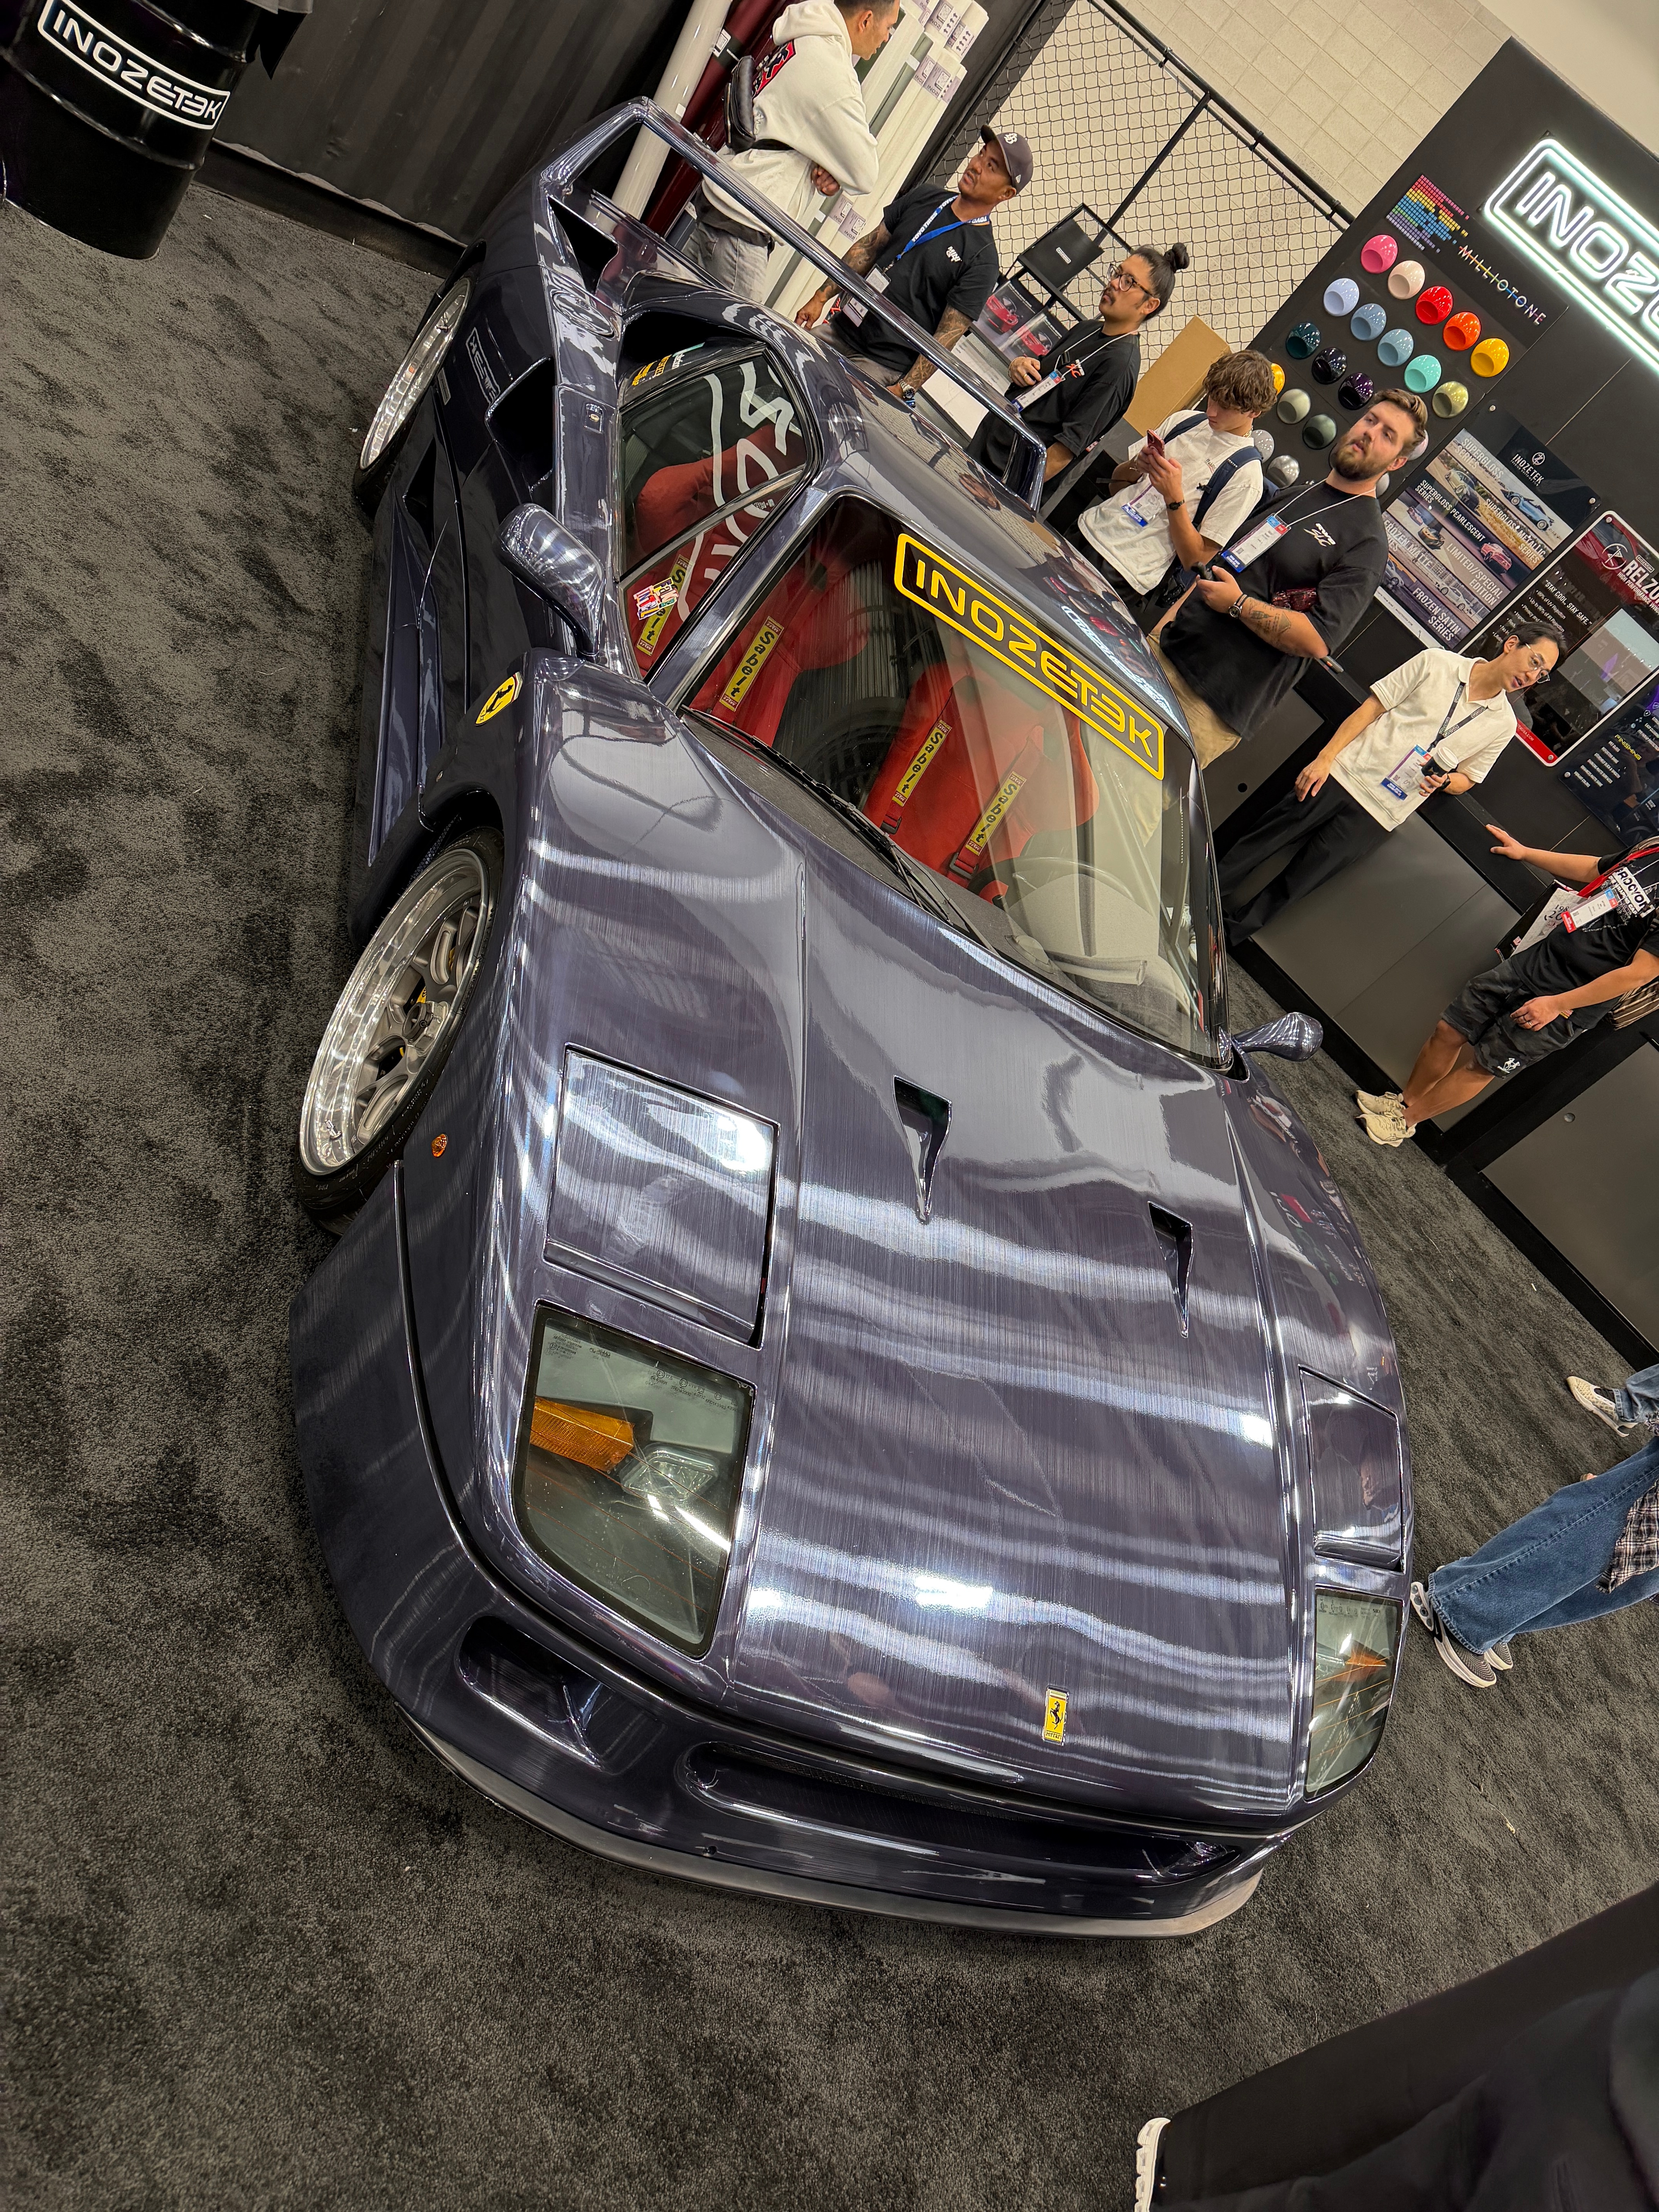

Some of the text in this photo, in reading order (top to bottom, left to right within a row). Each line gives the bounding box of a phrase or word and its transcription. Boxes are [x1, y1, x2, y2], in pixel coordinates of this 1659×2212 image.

[53, 10, 222, 120] INOZETEK
[912, 211, 938, 242] TOYO TIRES
[1515, 170, 1659, 335] INOZ
[1458, 245, 1547, 326] MILLIOTONE
[1454, 445, 1480, 470] SERIES
[1461, 437, 1504, 479] SUPERGLOSS
[1512, 453, 1544, 484] INOZETEK
[1414, 485, 1434, 504] SERIES
[1419, 479, 1486, 543] SUPERGLOSS PEARLESCENT
[1483, 498, 1546, 558] SUPERGLOSS METALLIC
[1381, 519, 1433, 569] FROZEN MATTE
[1517, 543, 1540, 564] SERIES
[1468, 578, 1497, 606] EDITION
[1617, 571, 1628, 582] HIGH
[1625, 579, 1652, 605] PERFORMANCE
[1622, 560, 1659, 606] RELZO
[647, 569, 685, 641] Selt
[1412, 587, 1441, 616] FROZEN
[1437, 611, 1462, 635] SATIN
[1551, 605, 1566, 620] Rejection
[1566, 602, 1579, 615] STAY
[766, 622, 781, 632] TRW
[1427, 615, 1455, 642] SERIES
[1550, 618, 1565, 633] Rejection
[731, 631, 775, 697] Sabelt
[916, 560, 1153, 758] INOZETEK
[723, 696, 737, 706] TRW
[938, 724, 948, 733] TRW
[902, 732, 943, 793] Sabelt
[1614, 733, 1642, 761] FINISHING
[1010, 776, 1022, 785] TRW
[895, 792, 906, 801] TRW
[976, 783, 1017, 843] Sabelt
[969, 841, 981, 850] TRW
[1046, 1730, 1062, 1740] Ferrari
